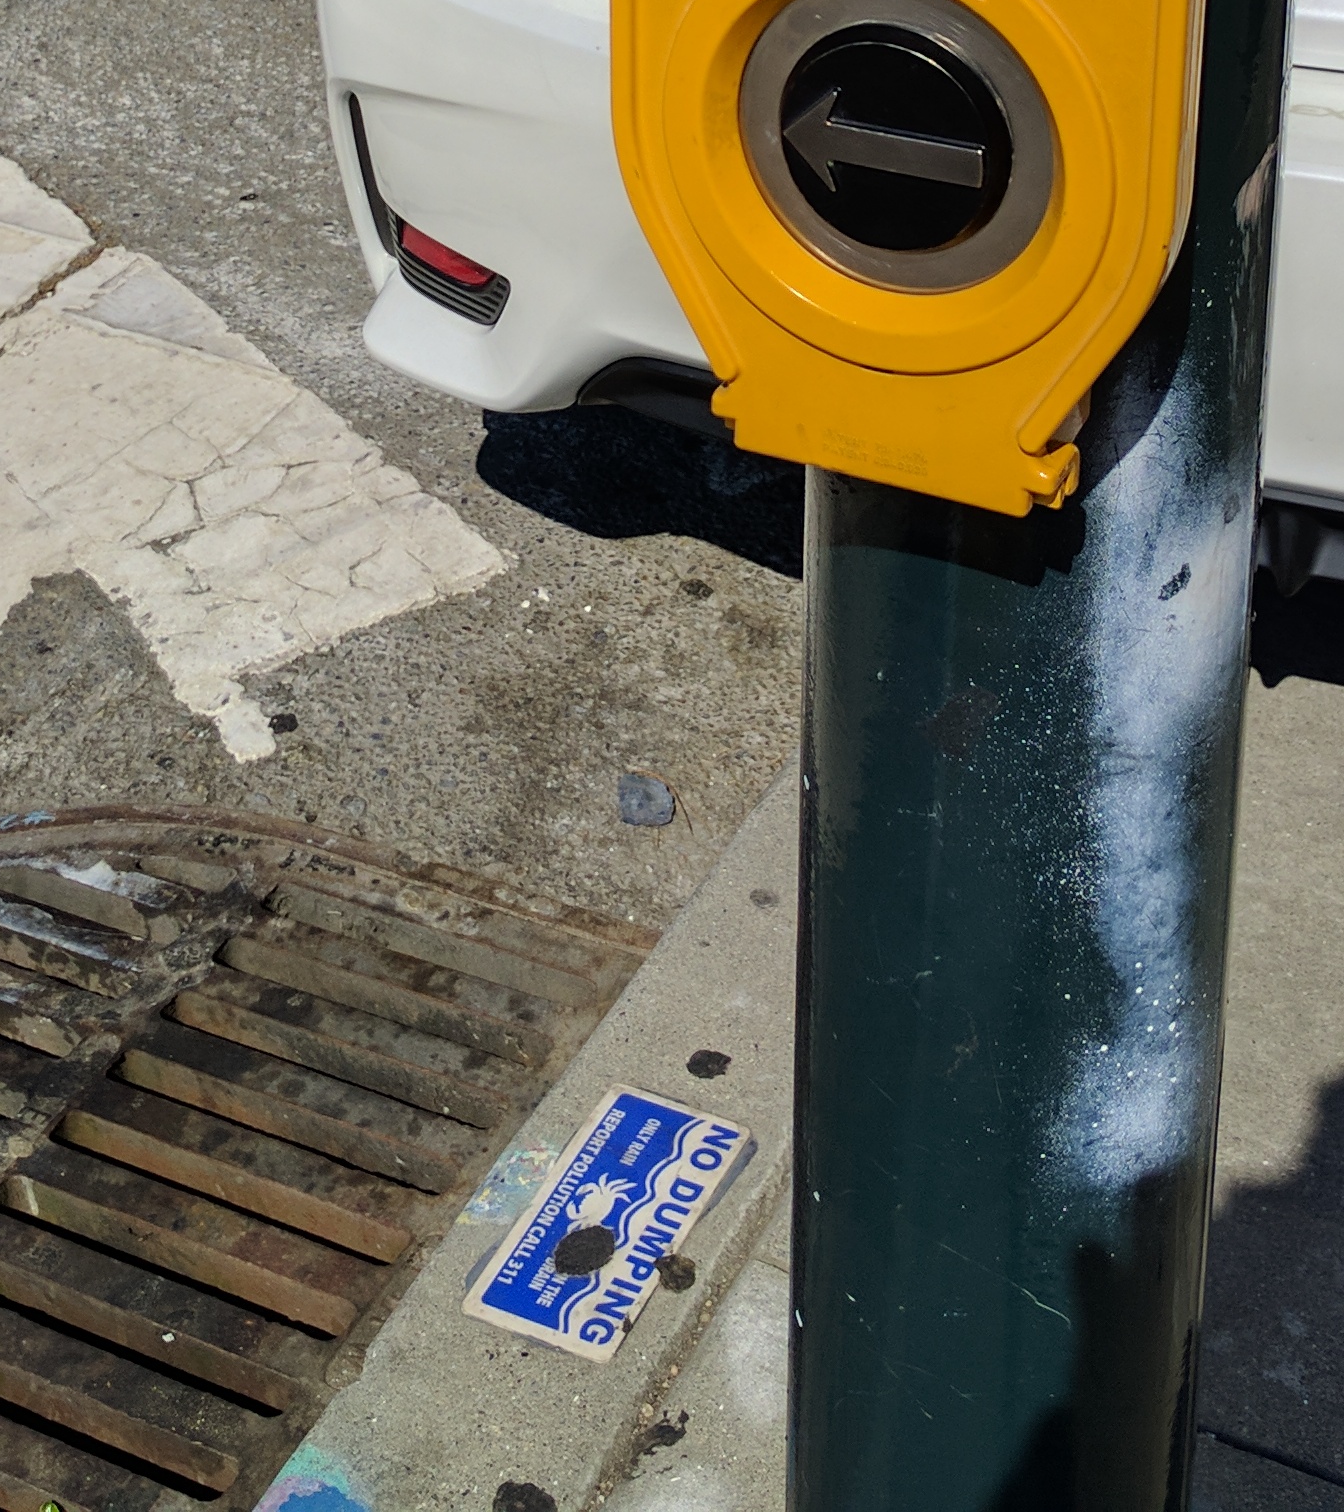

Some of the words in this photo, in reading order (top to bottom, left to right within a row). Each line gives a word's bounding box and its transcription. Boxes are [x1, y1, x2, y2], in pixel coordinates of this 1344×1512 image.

[582, 1107, 626, 1157] REPORT
[636, 1117, 662, 1144] ONLY
[689, 1122, 741, 1172] NO
[619, 1140, 646, 1167] RAIN
[534, 1152, 594, 1229] POLLUTION
[512, 1225, 547, 1262] CALL
[578, 1176, 705, 1346] DUMPING
[496, 1258, 524, 1285] 311
[535, 1280, 561, 1308] THE
